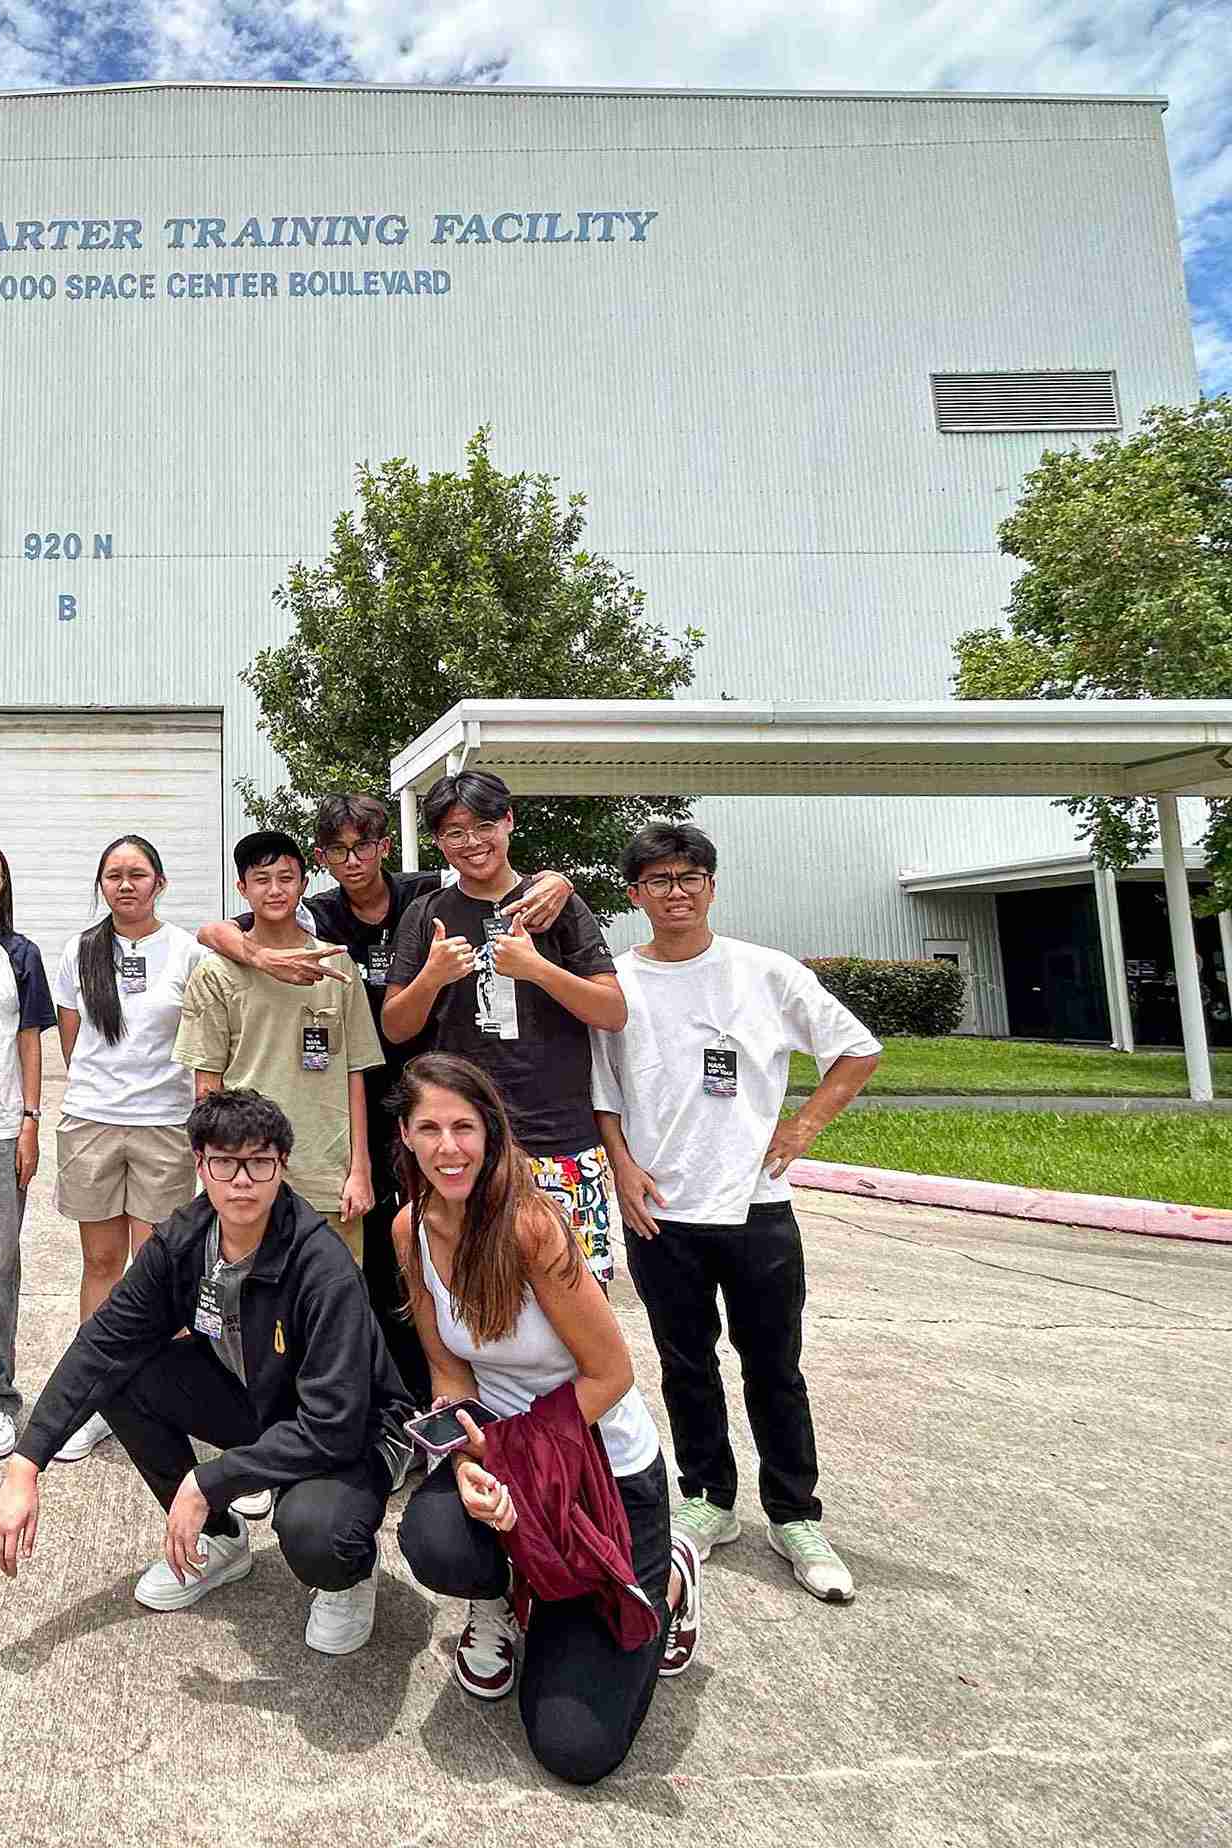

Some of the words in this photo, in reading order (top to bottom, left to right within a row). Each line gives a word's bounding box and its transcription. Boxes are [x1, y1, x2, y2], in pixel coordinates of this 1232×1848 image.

[164, 213, 409, 249] TRAINING
[429, 210, 659, 245] FACILITY
[65, 273, 156, 301] SPACE
[166, 272, 279, 299] CENTER
[288, 270, 452, 298] BOULEVARD
[24, 533, 82, 560] 920
[93, 534, 113, 559] N
[58, 594, 77, 621] B
